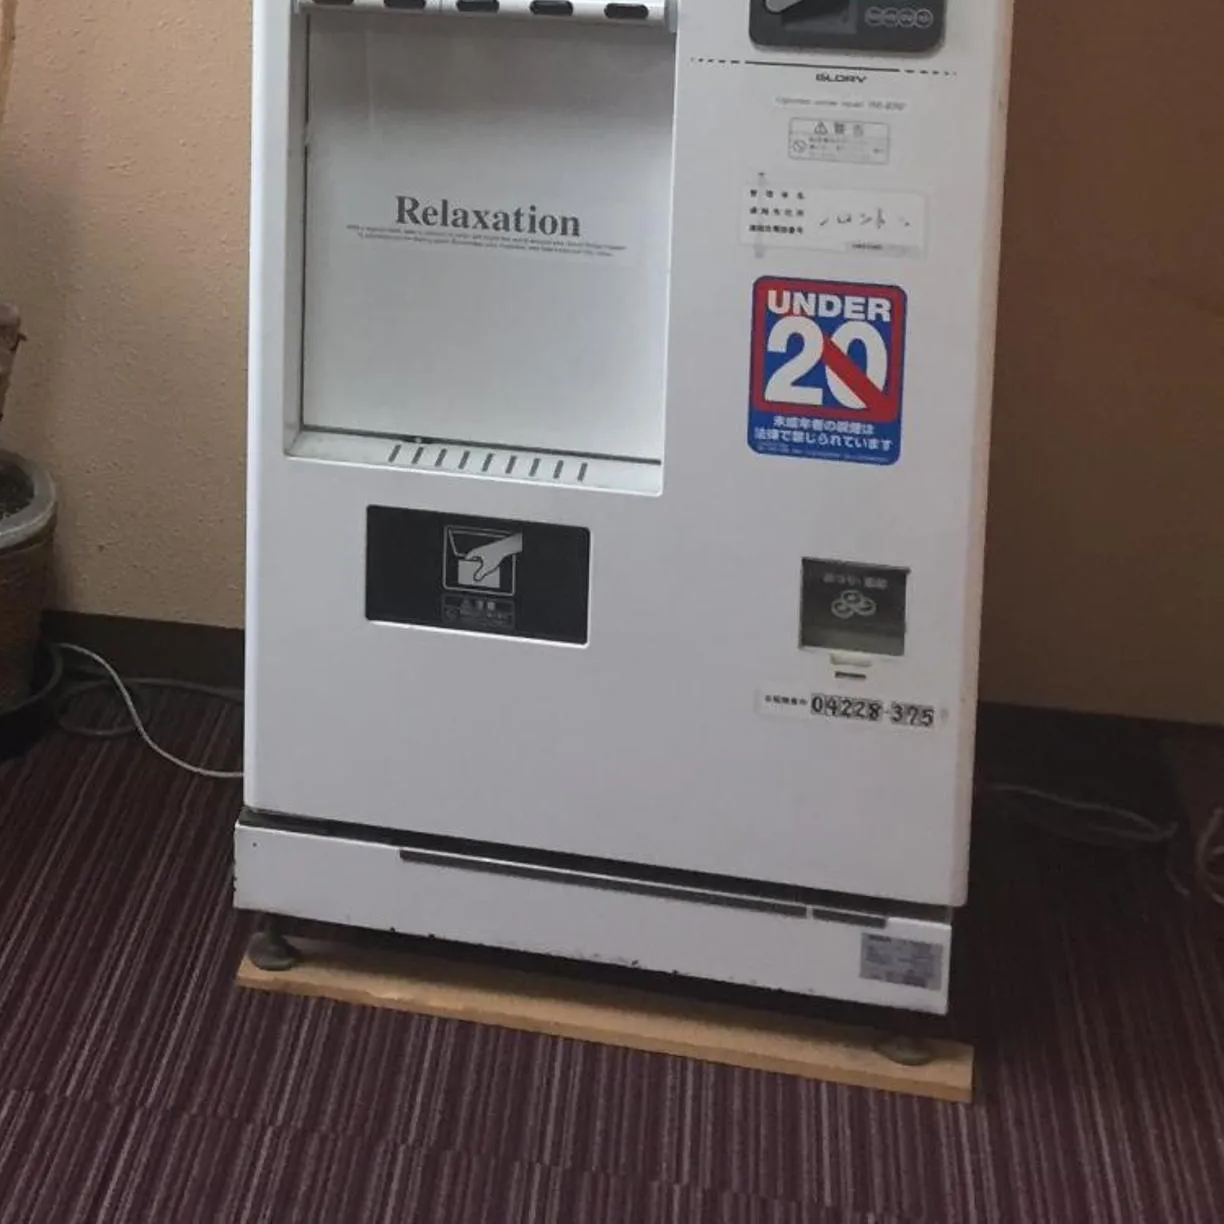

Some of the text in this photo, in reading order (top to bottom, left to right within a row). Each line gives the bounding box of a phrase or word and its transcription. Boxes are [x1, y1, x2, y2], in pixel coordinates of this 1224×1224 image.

[394, 195, 581, 237] Relaxation
[767, 289, 892, 323] UNDER
[764, 315, 888, 410] 20
